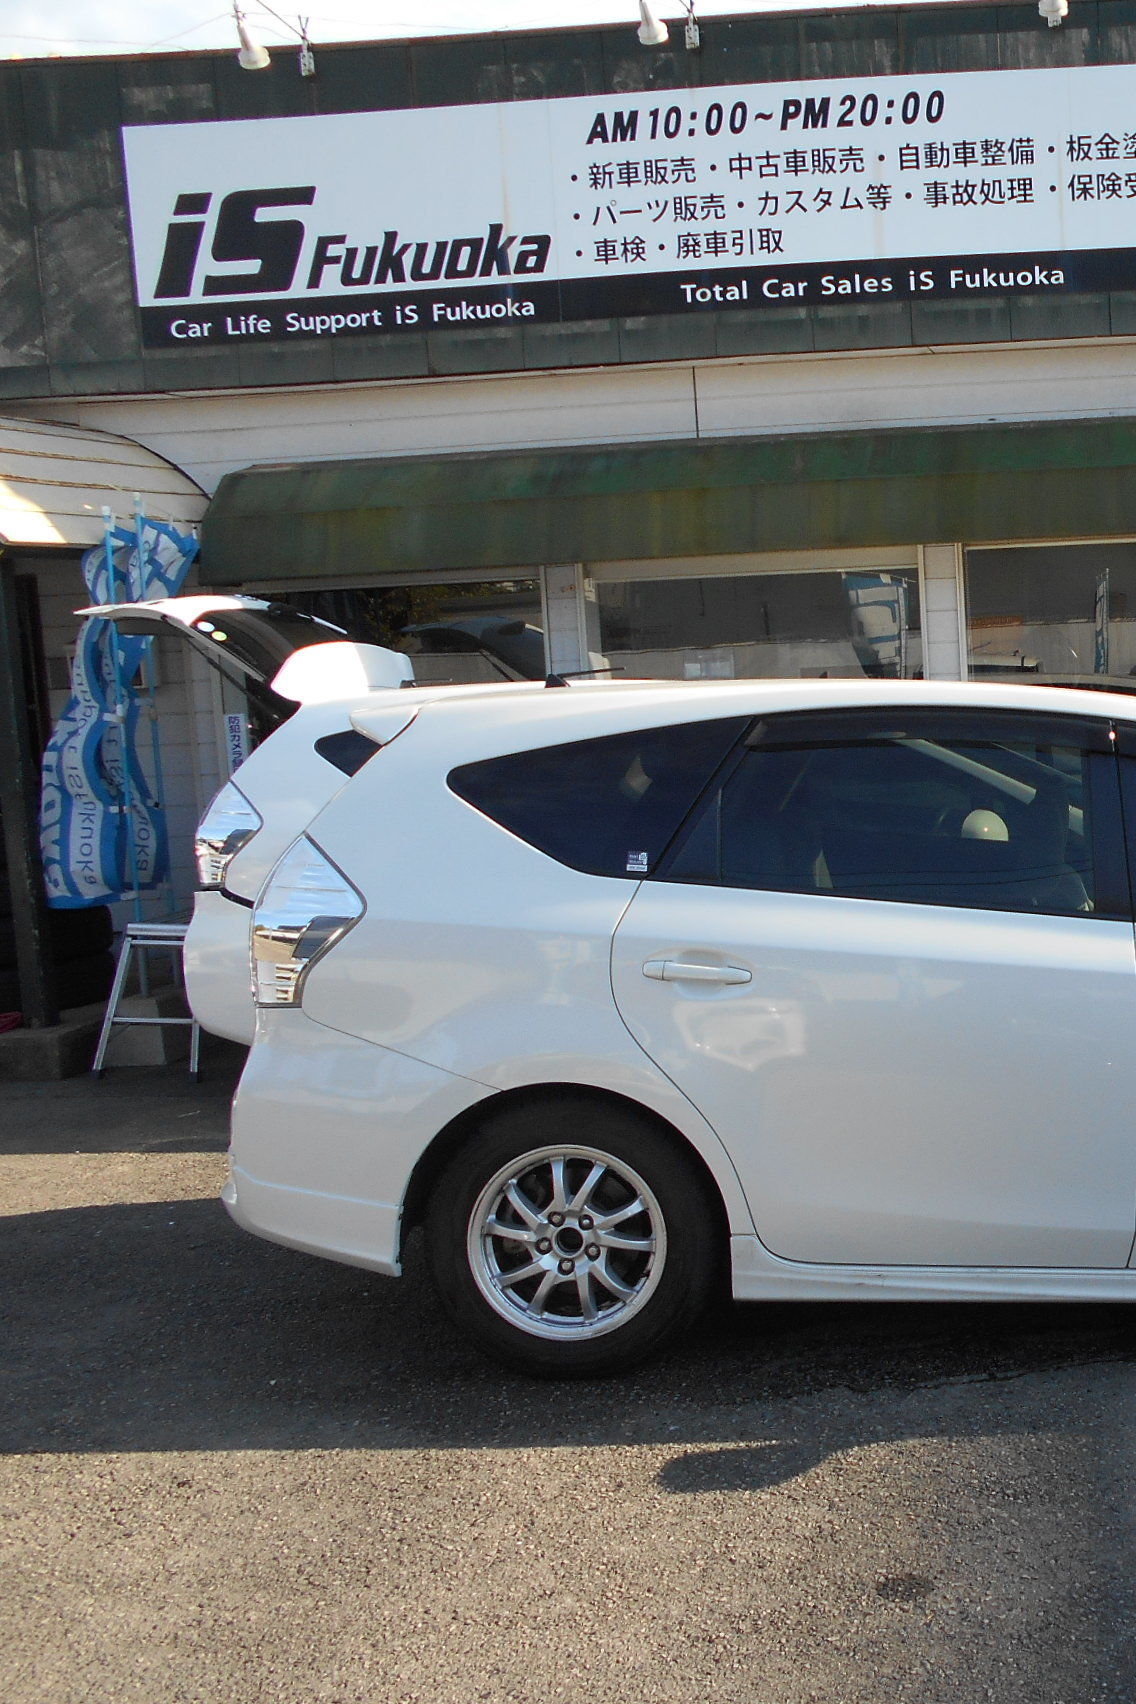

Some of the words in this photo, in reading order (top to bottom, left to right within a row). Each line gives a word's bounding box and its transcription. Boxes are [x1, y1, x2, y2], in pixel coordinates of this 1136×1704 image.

[306, 223, 552, 289] Fukuoka
[681, 279, 749, 304] Total
[762, 276, 808, 300] Car
[821, 271, 894, 296] Sales
[908, 269, 935, 292] iS
[950, 265, 1066, 290] Fukuoka
[169, 319, 212, 340] Car
[226, 314, 272, 337] Life
[286, 308, 383, 334] Support
[395, 305, 420, 326] iS
[432, 299, 536, 323] Fukuoka
